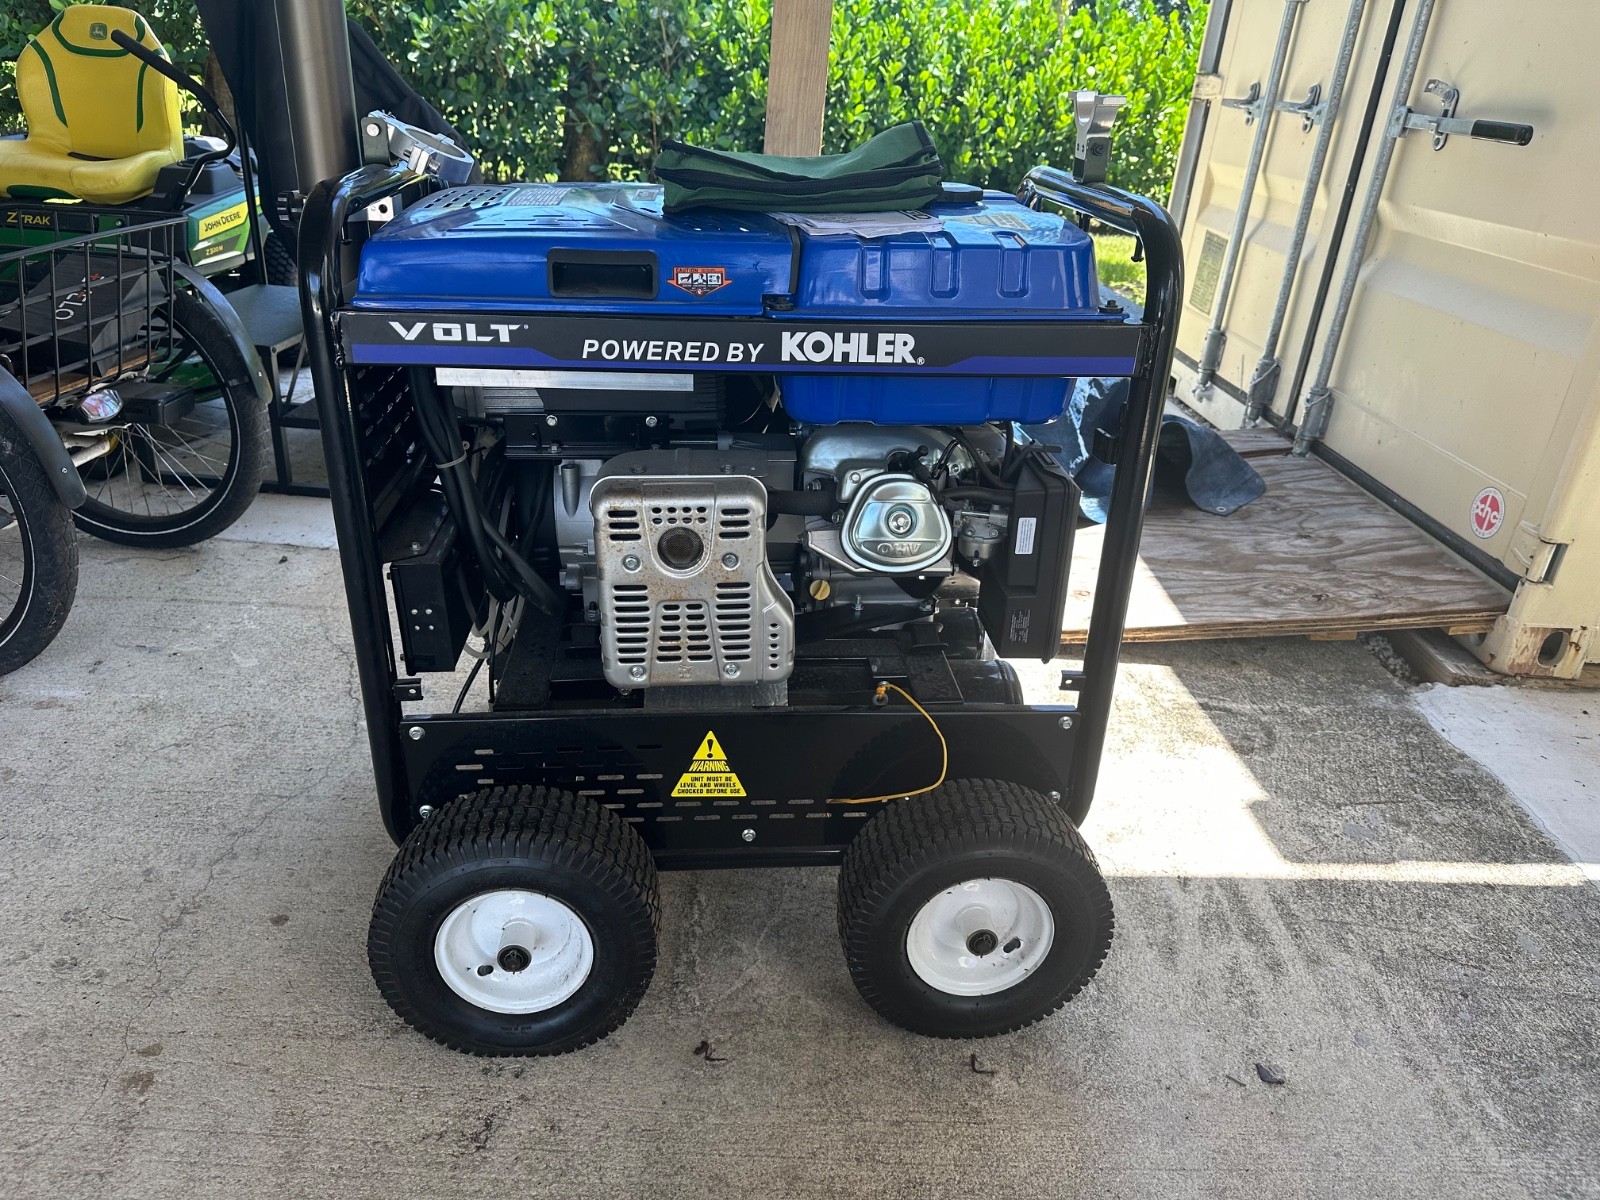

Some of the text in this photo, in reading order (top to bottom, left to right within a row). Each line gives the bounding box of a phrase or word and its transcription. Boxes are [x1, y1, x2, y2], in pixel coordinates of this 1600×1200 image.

[204, 211, 241, 231] JOHN DEERE
[388, 321, 521, 342] VOLT
[582, 339, 720, 362] POWERED
[726, 343, 764, 363] BY
[877, 542, 921, 556] OHV
[689, 761, 730, 771] WARNING
